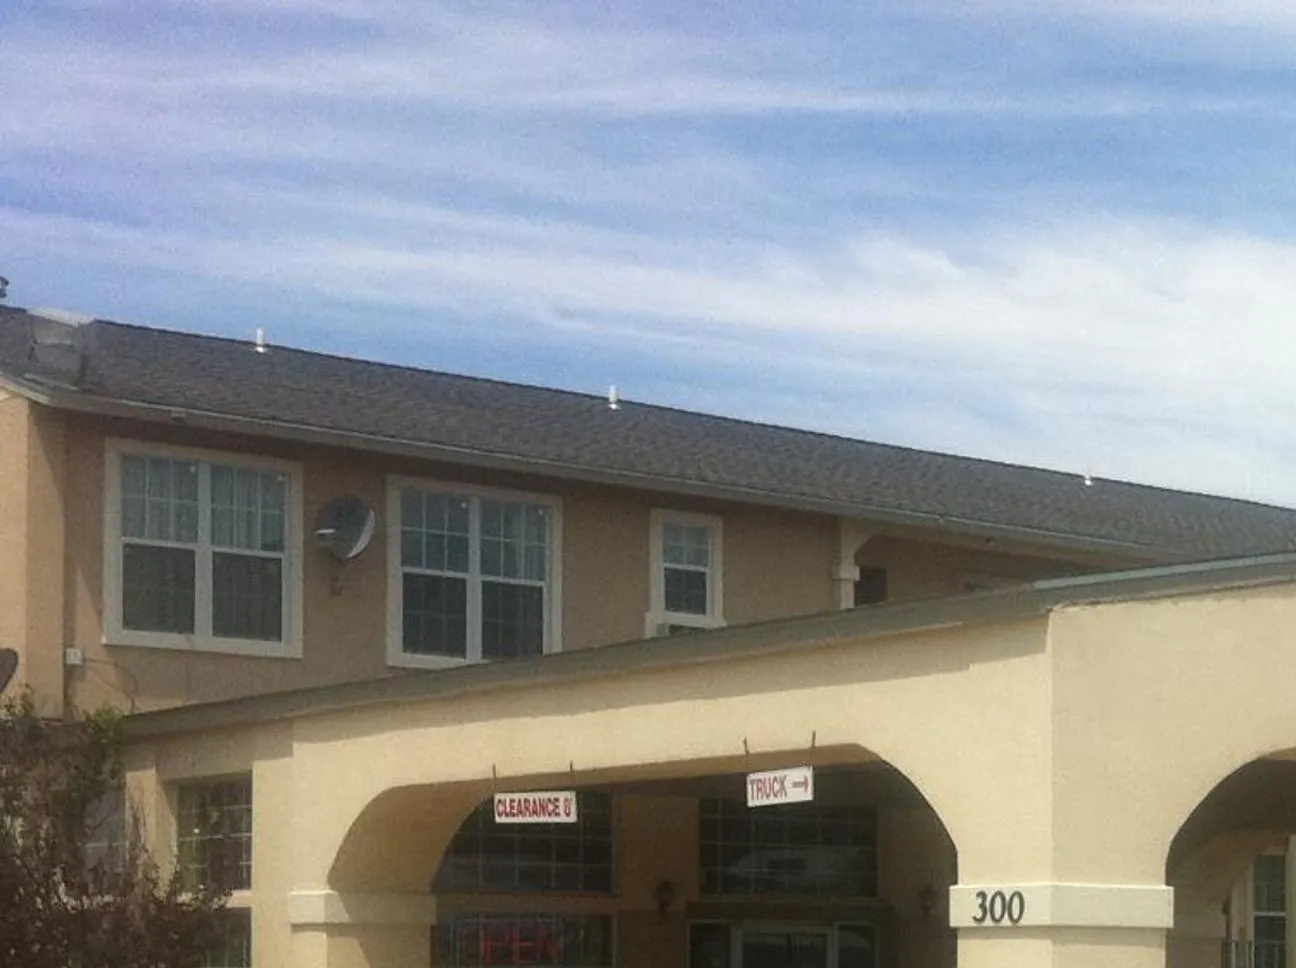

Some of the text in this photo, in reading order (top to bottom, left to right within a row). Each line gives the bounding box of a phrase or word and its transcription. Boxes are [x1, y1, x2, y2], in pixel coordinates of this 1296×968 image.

[750, 775, 788, 800] TRUCK
[496, 797, 561, 817] CLEARANCE
[972, 890, 1025, 925] 300
